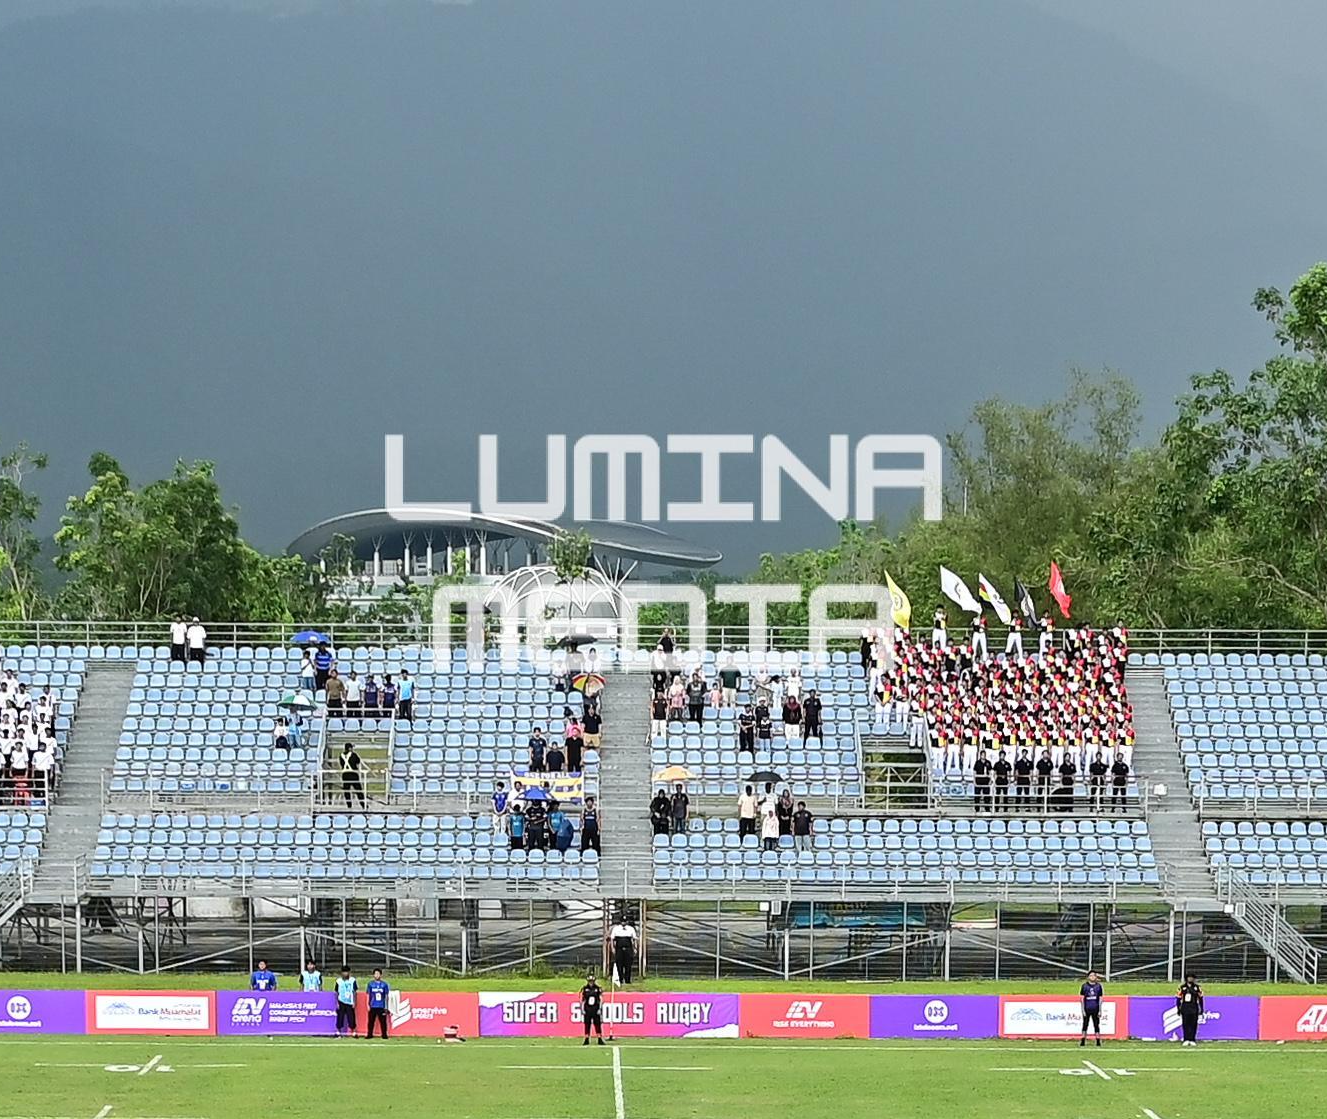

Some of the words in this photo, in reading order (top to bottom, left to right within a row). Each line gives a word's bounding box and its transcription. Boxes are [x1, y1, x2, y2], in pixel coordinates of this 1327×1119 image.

[502, 1002, 558, 1023] SUPER
[570, 1002, 644, 1024] SOOLS
[657, 1003, 712, 1026] RUGBY
